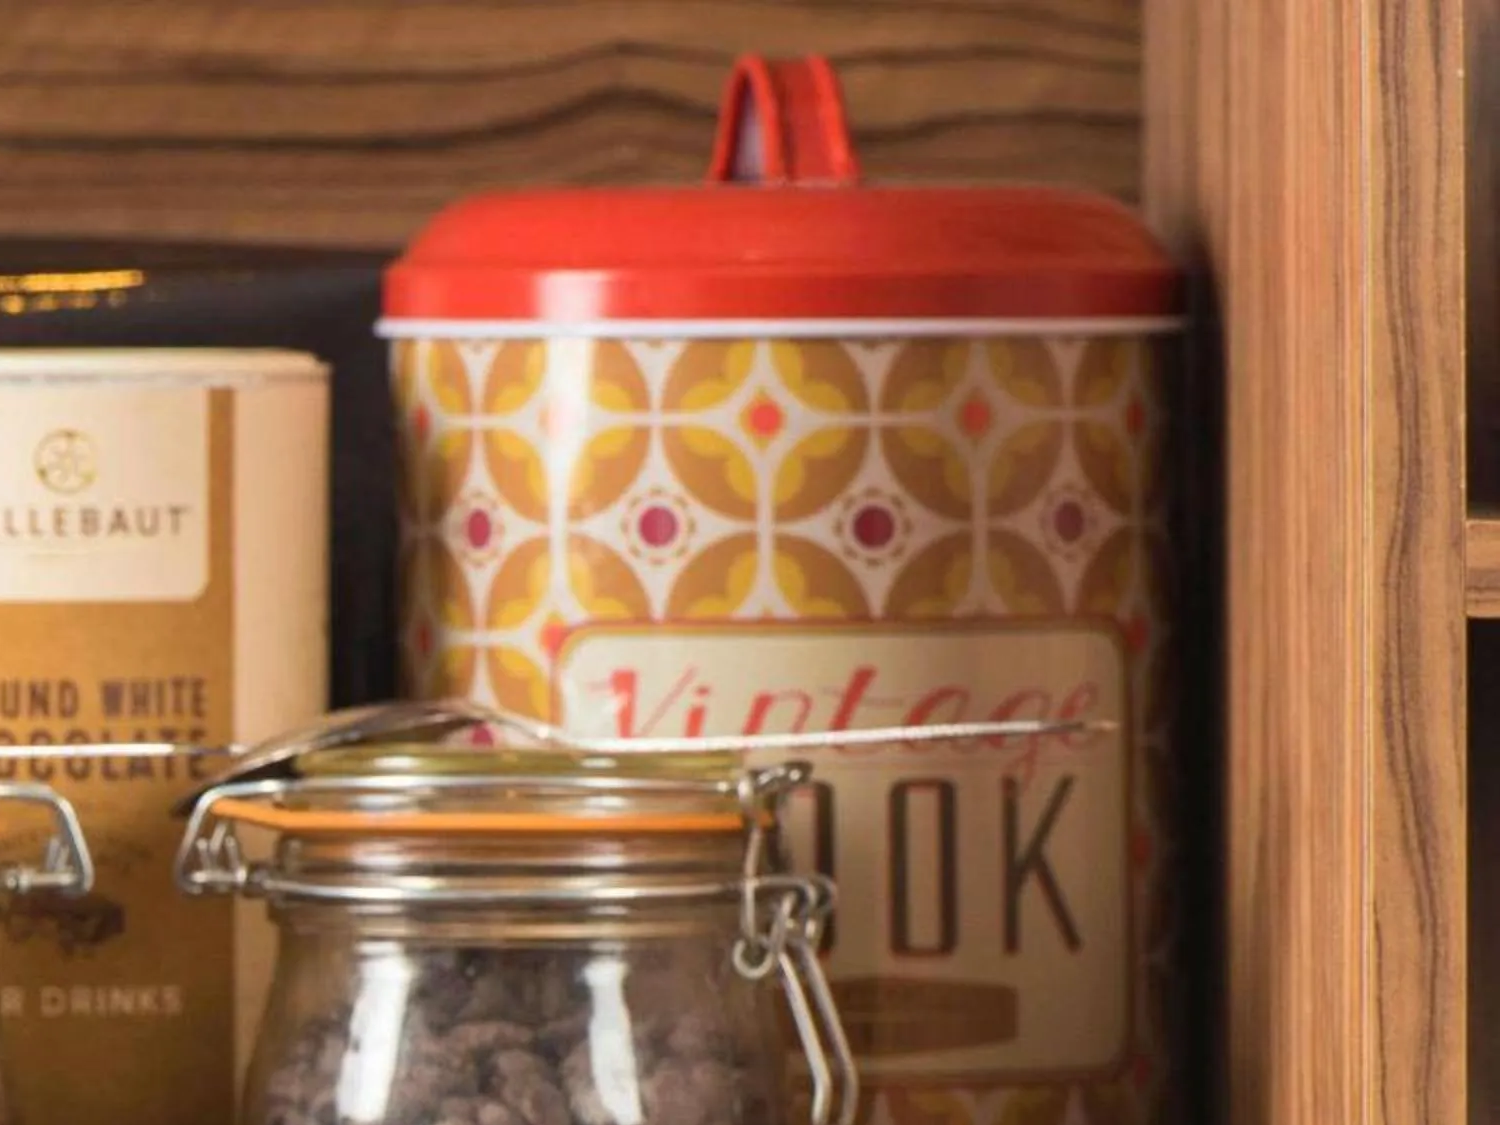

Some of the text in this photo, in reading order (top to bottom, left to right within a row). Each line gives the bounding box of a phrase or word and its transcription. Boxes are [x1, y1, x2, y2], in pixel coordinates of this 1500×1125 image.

[102, 677, 206, 718] WHITE
[768, 774, 1083, 957] OOK
[40, 985, 182, 1018] DRINKS
